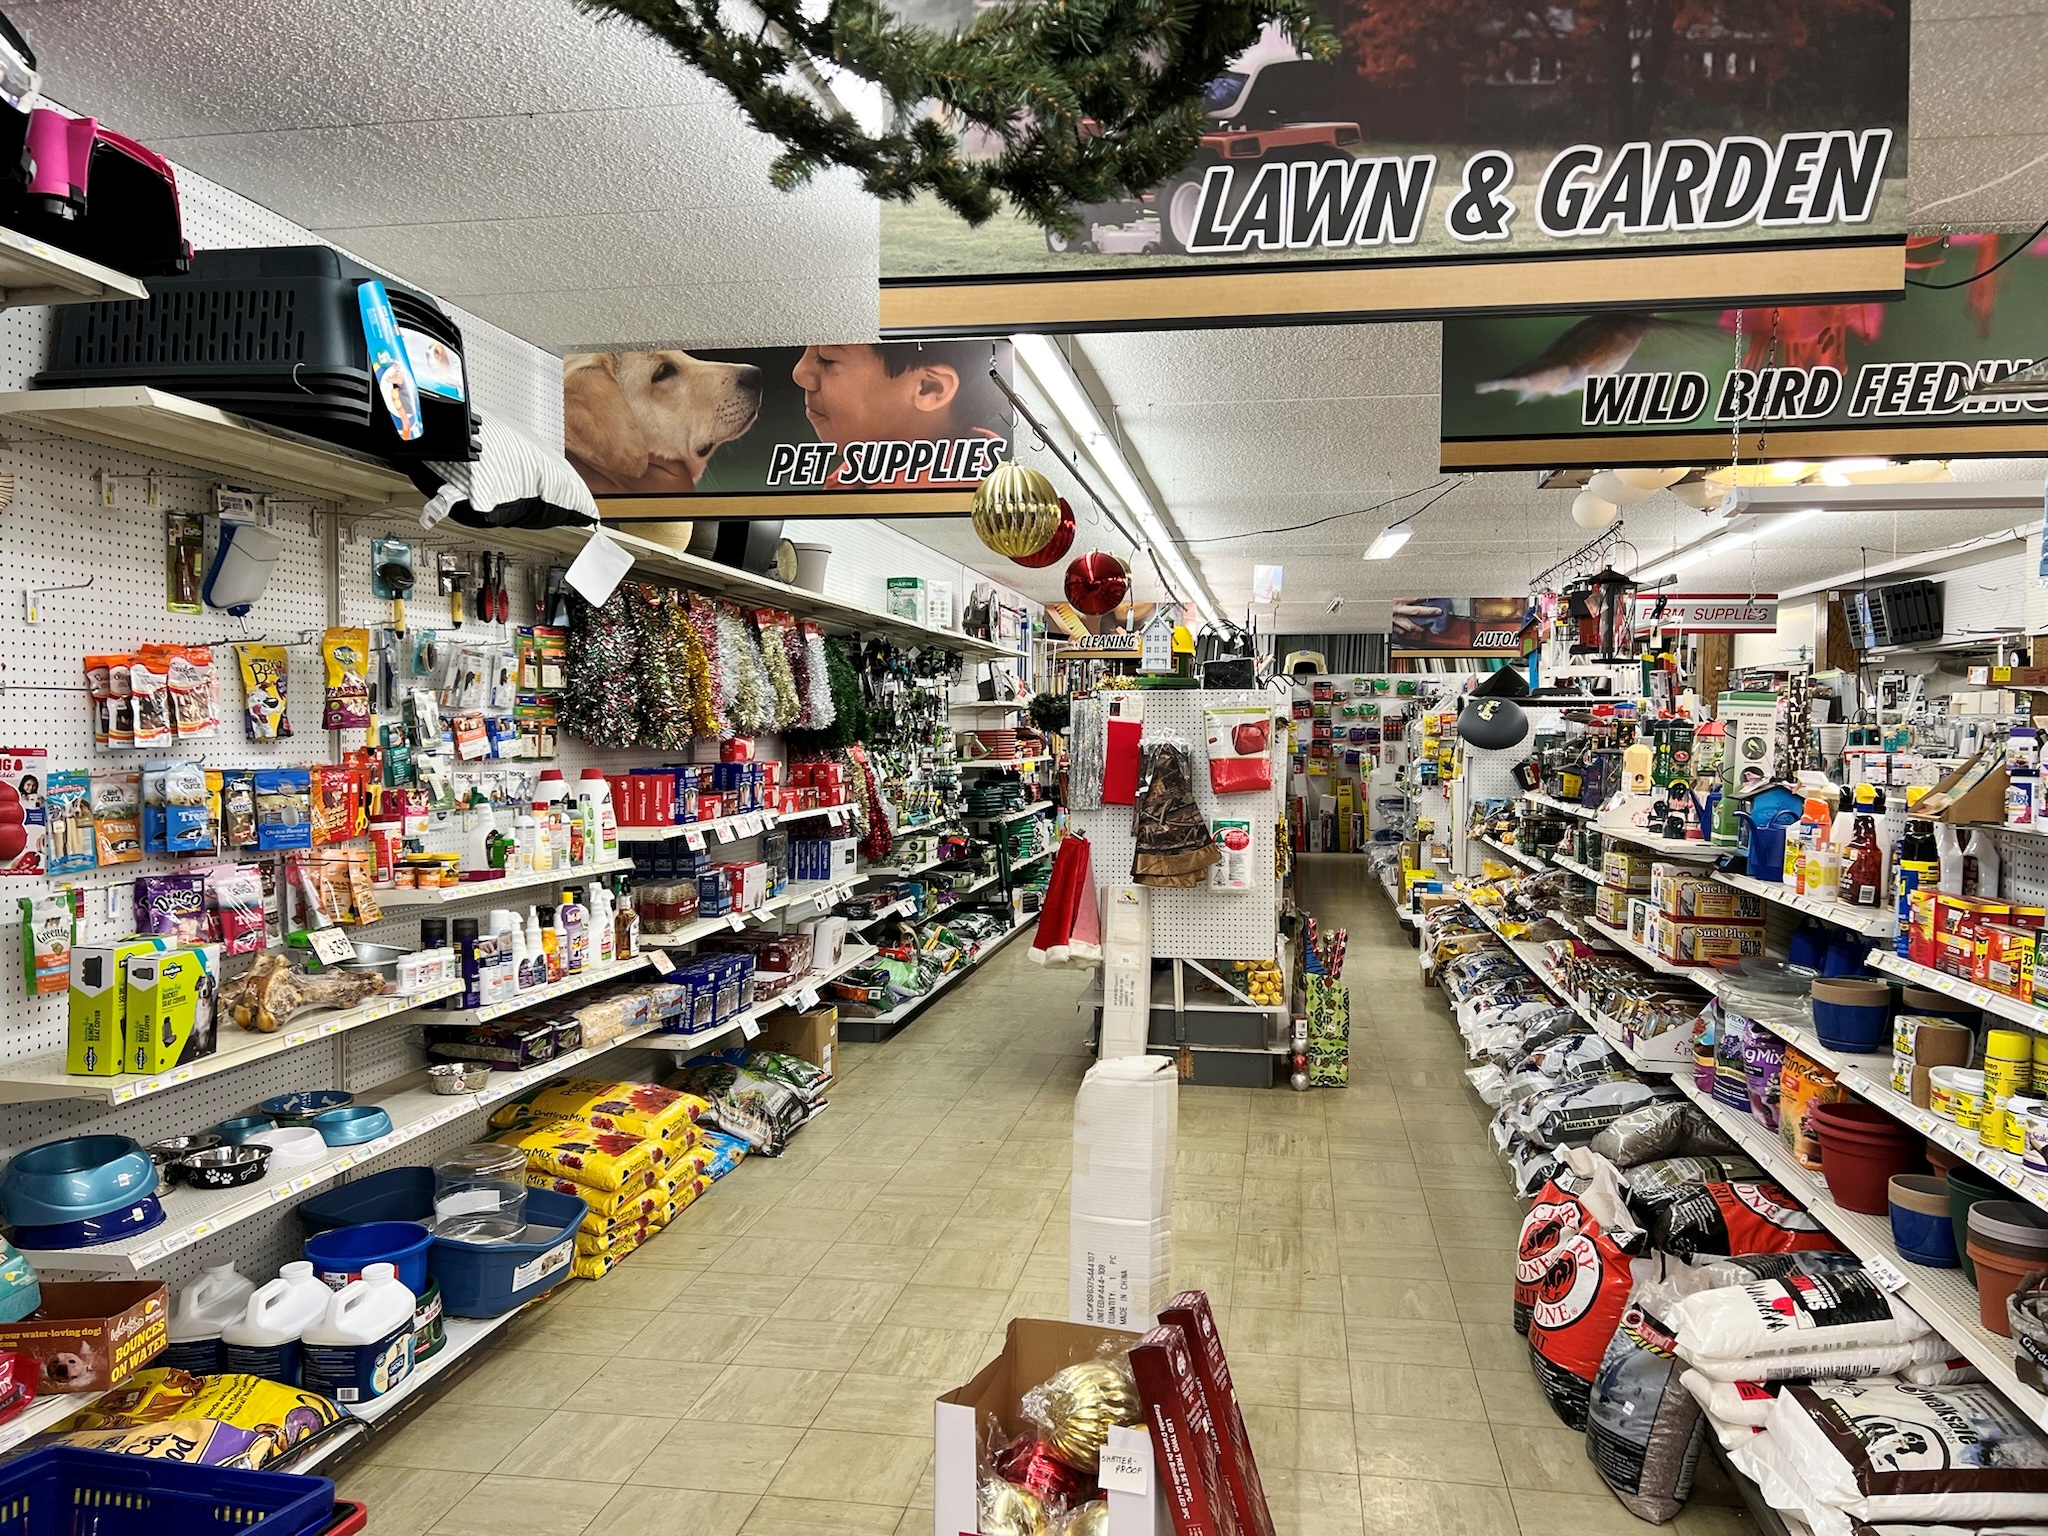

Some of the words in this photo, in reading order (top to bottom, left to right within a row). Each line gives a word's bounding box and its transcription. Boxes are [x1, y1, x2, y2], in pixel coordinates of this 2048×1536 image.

[1187, 154, 1436, 253] LAWN
[1448, 149, 1514, 241] &
[1536, 129, 1894, 238] GARDEN
[1581, 370, 1710, 425] WILD
[1715, 366, 1843, 422] BIRD
[767, 442, 837, 486] PET
[838, 438, 1007, 484] SUPPLIES
[889, 580, 913, 588] CHAPIN
[1693, 607, 1768, 620] SUPPLIES
[1079, 634, 1135, 649] CLEANING
[1696, 882, 1721, 894] Suet
[153, 889, 203, 913] DINGO
[36, 927, 70, 945] Greenies
[1696, 926, 1721, 938] Suet
[1725, 928, 1751, 939] Plus
[569, 1112, 587, 1124] Mix
[532, 1147, 552, 1160] Mix
[526, 1174, 548, 1187] Mix
[1109, 1255, 1117, 1265] PC
[1120, 1270, 1128, 1290] CHINA
[1120, 1294, 1127, 1302] IN
[1119, 1307, 1127, 1325] MADE
[0, 1332, 20, 1342] your
[22, 1329, 81, 1339] water-loving
[82, 1327, 102, 1338] dog!
[115, 1317, 165, 1363] BOUNCES
[111, 1361, 127, 1383] ON
[128, 1333, 167, 1370] WATER
[1165, 1418, 1175, 1434] LED
[1917, 1393, 1979, 1446] walksafe
[1170, 1434, 1179, 1453] TWIG
[1942, 1428, 1957, 1446] Pets
[1100, 1454, 1137, 1467] SHATTER-
[1174, 1453, 1185, 1473] TREE
[1115, 1464, 1143, 1475] PROOF
[1180, 1472, 1189, 1488] SET
[1178, 1494, 1186, 1508] LED
[1185, 1486, 1194, 1503] 5PC
